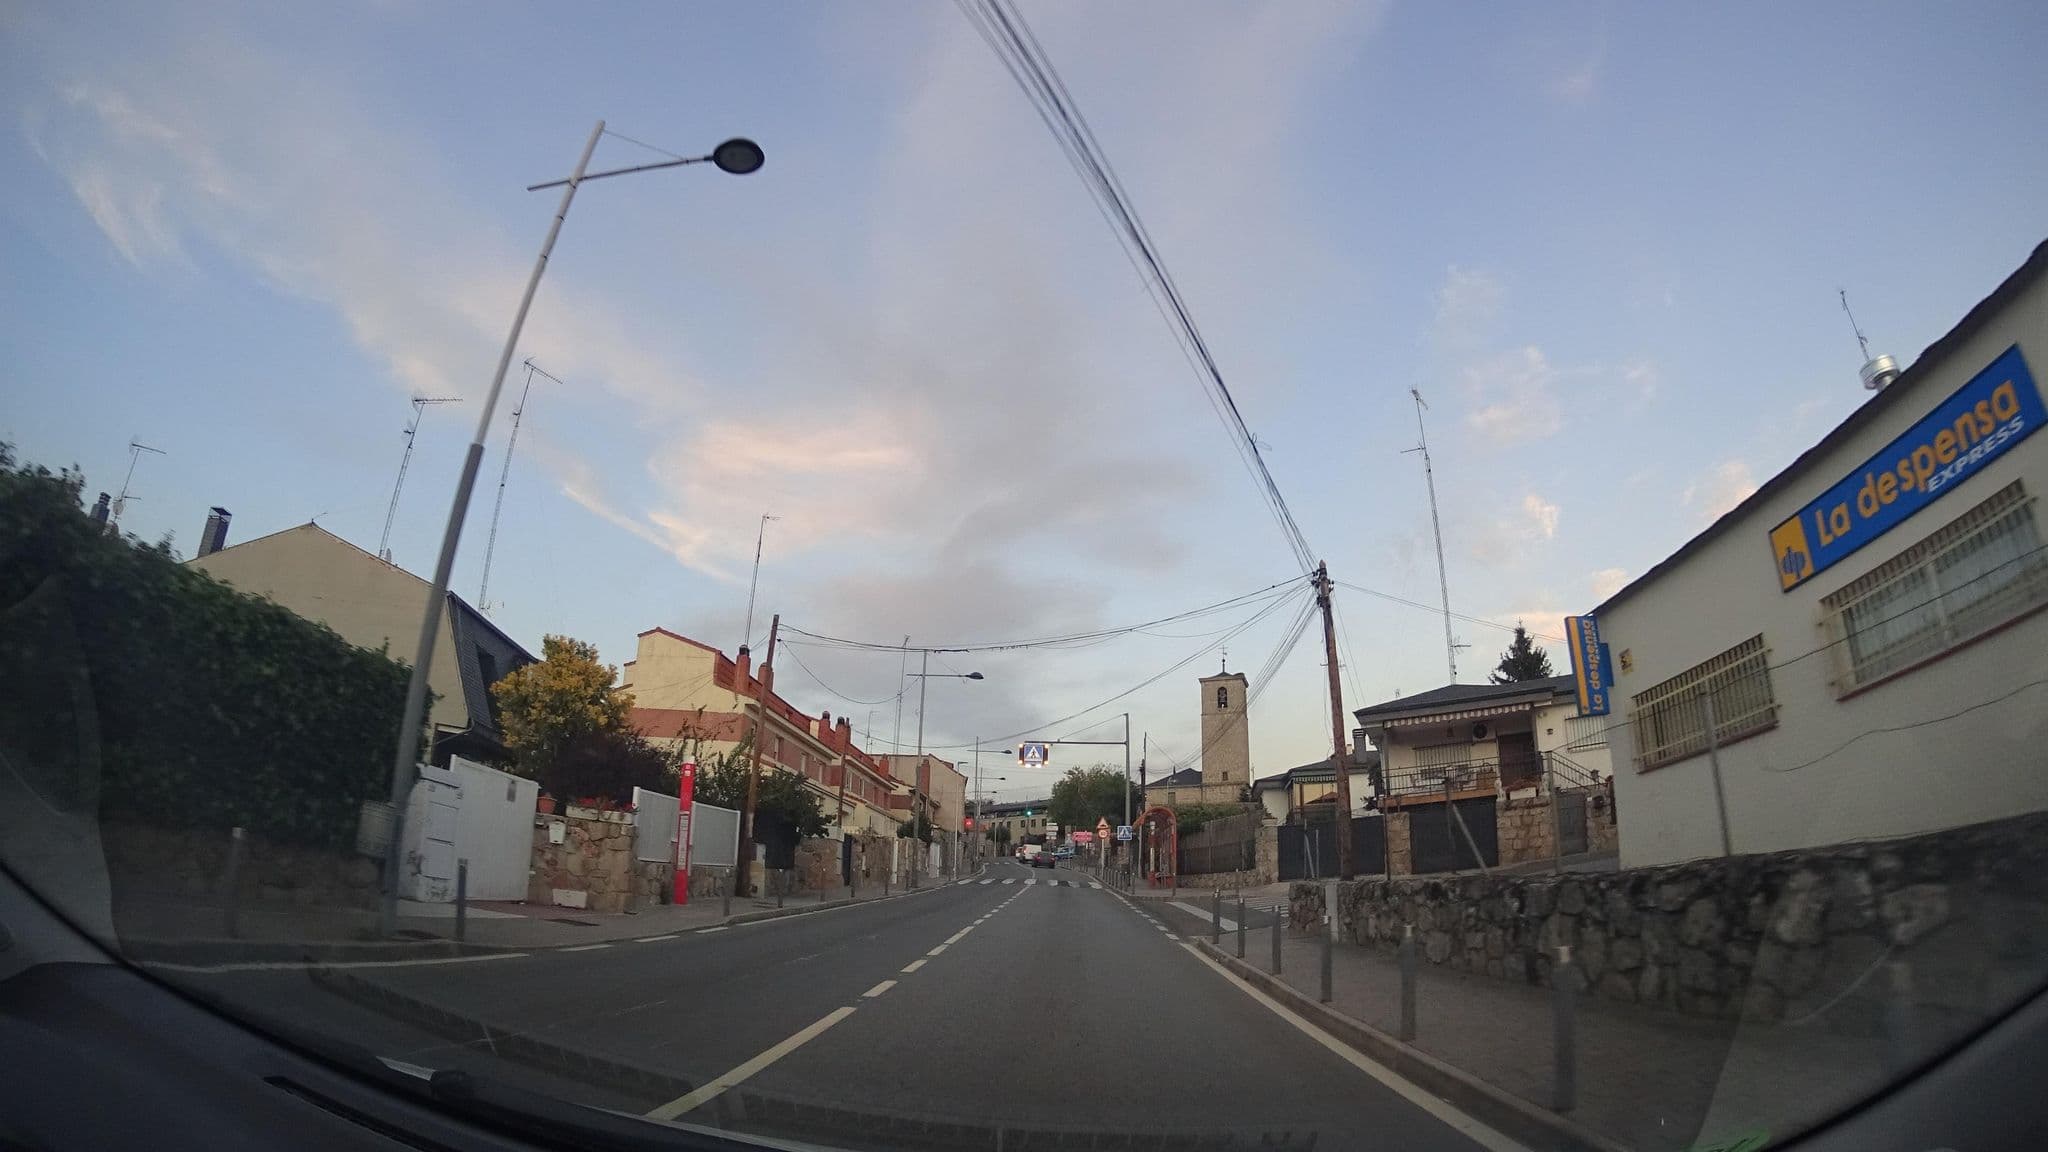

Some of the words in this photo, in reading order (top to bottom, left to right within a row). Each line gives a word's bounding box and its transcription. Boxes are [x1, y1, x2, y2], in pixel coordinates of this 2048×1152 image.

[1815, 502, 1851, 547] La
[1858, 379, 2022, 519] despensa
[1927, 416, 2025, 493] EXPRESS
[1583, 619, 1601, 689] despensa
[1593, 694, 1604, 711] La
